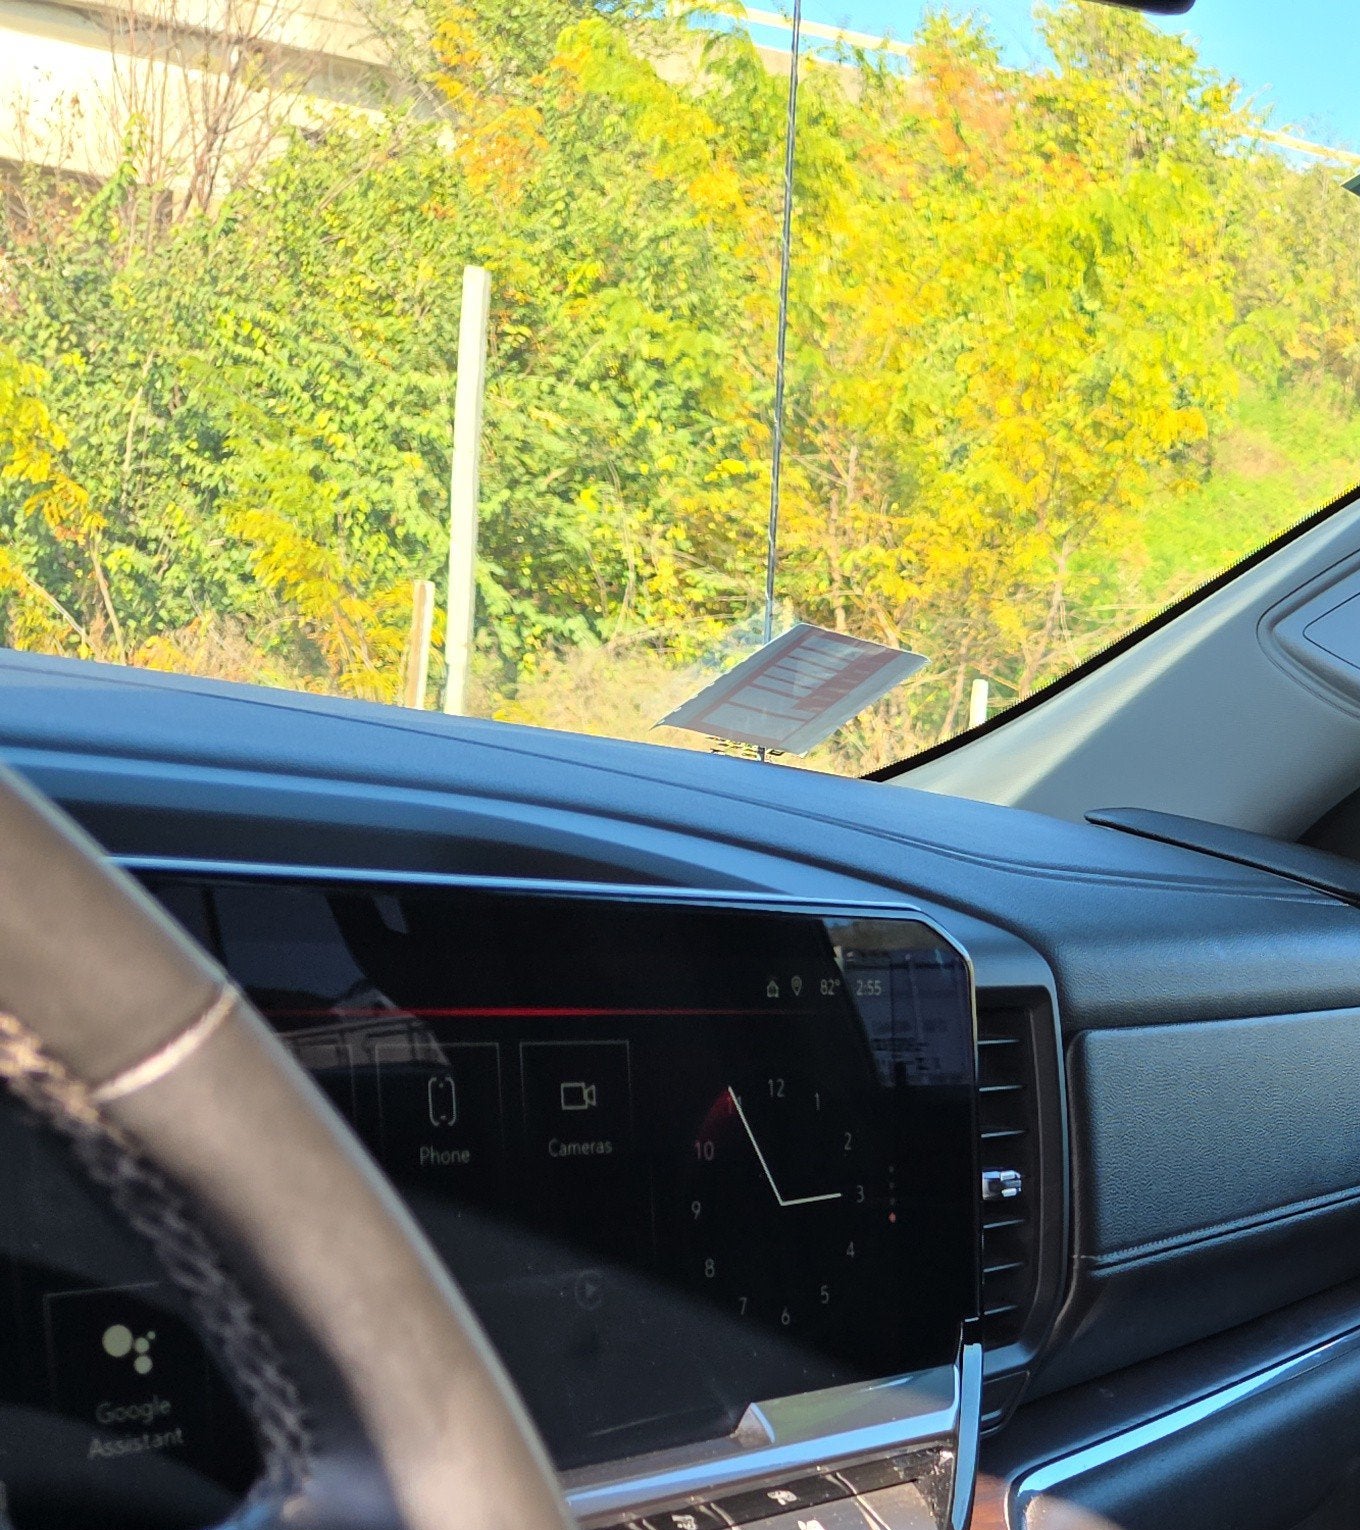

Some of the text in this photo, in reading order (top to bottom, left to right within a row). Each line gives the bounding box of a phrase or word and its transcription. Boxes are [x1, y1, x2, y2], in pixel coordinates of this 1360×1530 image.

[856, 979, 882, 997] 2:55
[767, 1078, 785, 1098] 12
[814, 1091, 822, 1111] 1
[548, 1137, 613, 1158] Cameras
[694, 1141, 715, 1161] 10
[843, 1132, 853, 1151] 2
[419, 1145, 471, 1165] Phone
[855, 1185, 865, 1204] 3
[690, 1200, 702, 1220] 9
[846, 1241, 856, 1258] 4
[704, 1258, 715, 1278] 8
[820, 1285, 830, 1304] 5
[738, 1297, 748, 1315] 7
[780, 1307, 791, 1326] 6
[95, 1395, 172, 1425] Google
[87, 1428, 185, 1459] Assistant
